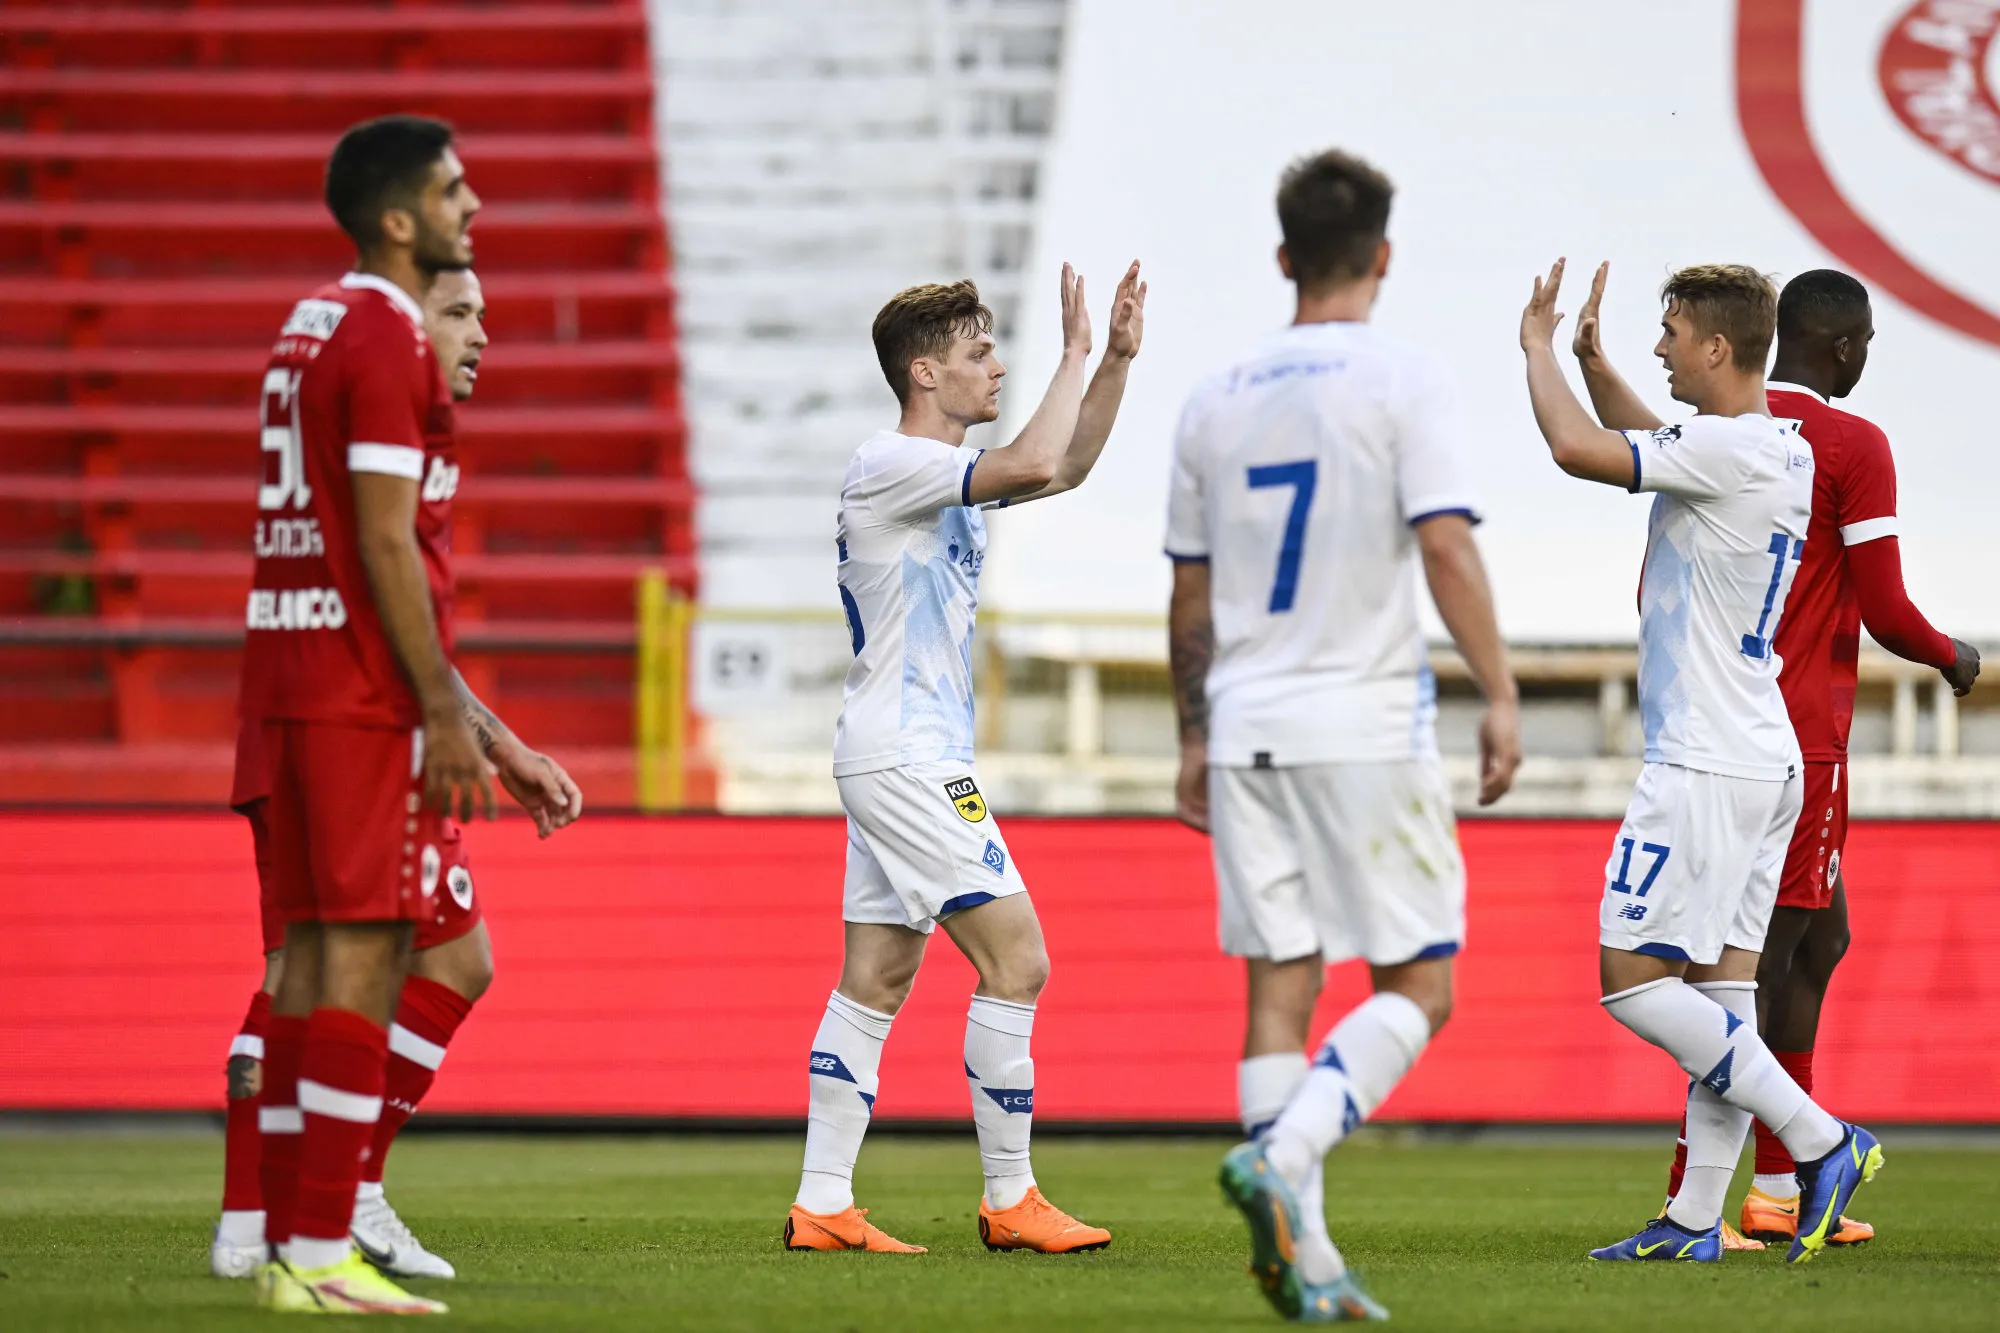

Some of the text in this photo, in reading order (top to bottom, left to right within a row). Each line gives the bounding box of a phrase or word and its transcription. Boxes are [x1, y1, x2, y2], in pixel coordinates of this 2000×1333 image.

[1246, 458, 1318, 614] 7
[1740, 532, 1806, 660] 1
[947, 780, 974, 798] KLO
[1611, 838, 1670, 897] 17
